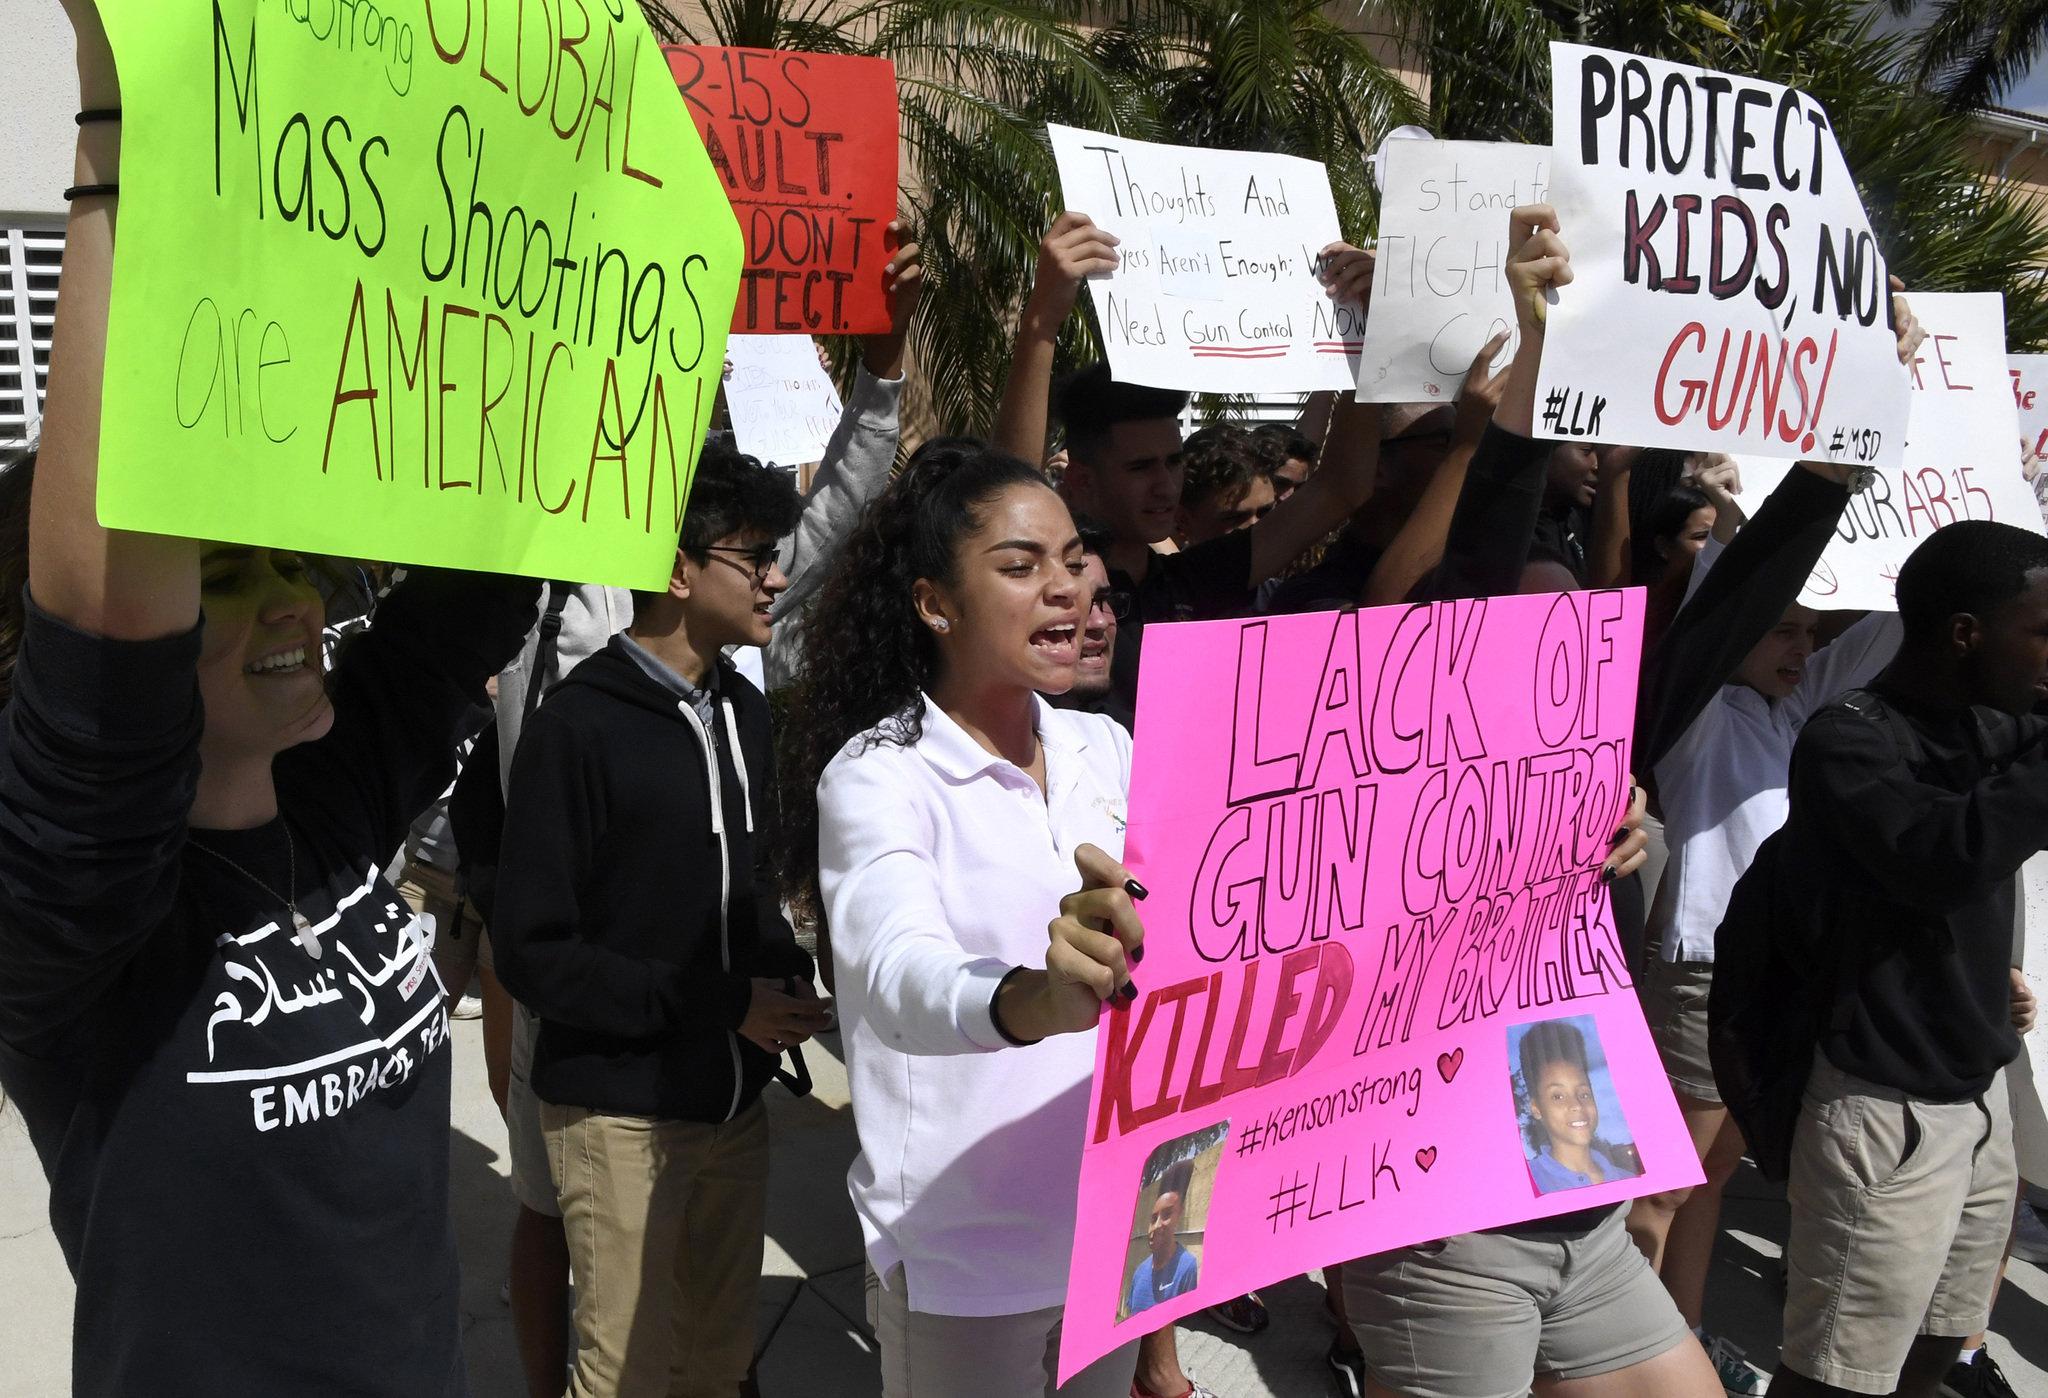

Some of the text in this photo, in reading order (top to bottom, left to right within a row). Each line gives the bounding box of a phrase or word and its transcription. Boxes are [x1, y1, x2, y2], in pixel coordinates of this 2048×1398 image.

[663, 46, 811, 128] R-15'S
[1580, 54, 1828, 196] PROTECT
[706, 122, 853, 196] AULT.
[1083, 145, 1290, 224] Thoughts And
[211, 0, 708, 451] Mass Shootings
[1119, 247, 1150, 274] yers
[1379, 235, 1499, 298] TIGH
[1623, 188, 1879, 331] KIDS, NO
[740, 267, 854, 331] TECT.
[1107, 290, 1166, 346] Need
[1182, 309, 1230, 345] Gun
[1238, 308, 1293, 340] Control
[176, 278, 703, 534] are AMERICAN
[1541, 386, 1882, 463] #LLK #MSD
[1654, 321, 1838, 453] GUNS!
[1227, 589, 1624, 808] LACK OF
[1190, 783, 1378, 961] GUN
[420, 1005, 450, 1063] PEA
[1093, 868, 1635, 1145] KILLED MY BROTHER
[1265, 1138, 1401, 1235] #LLK
